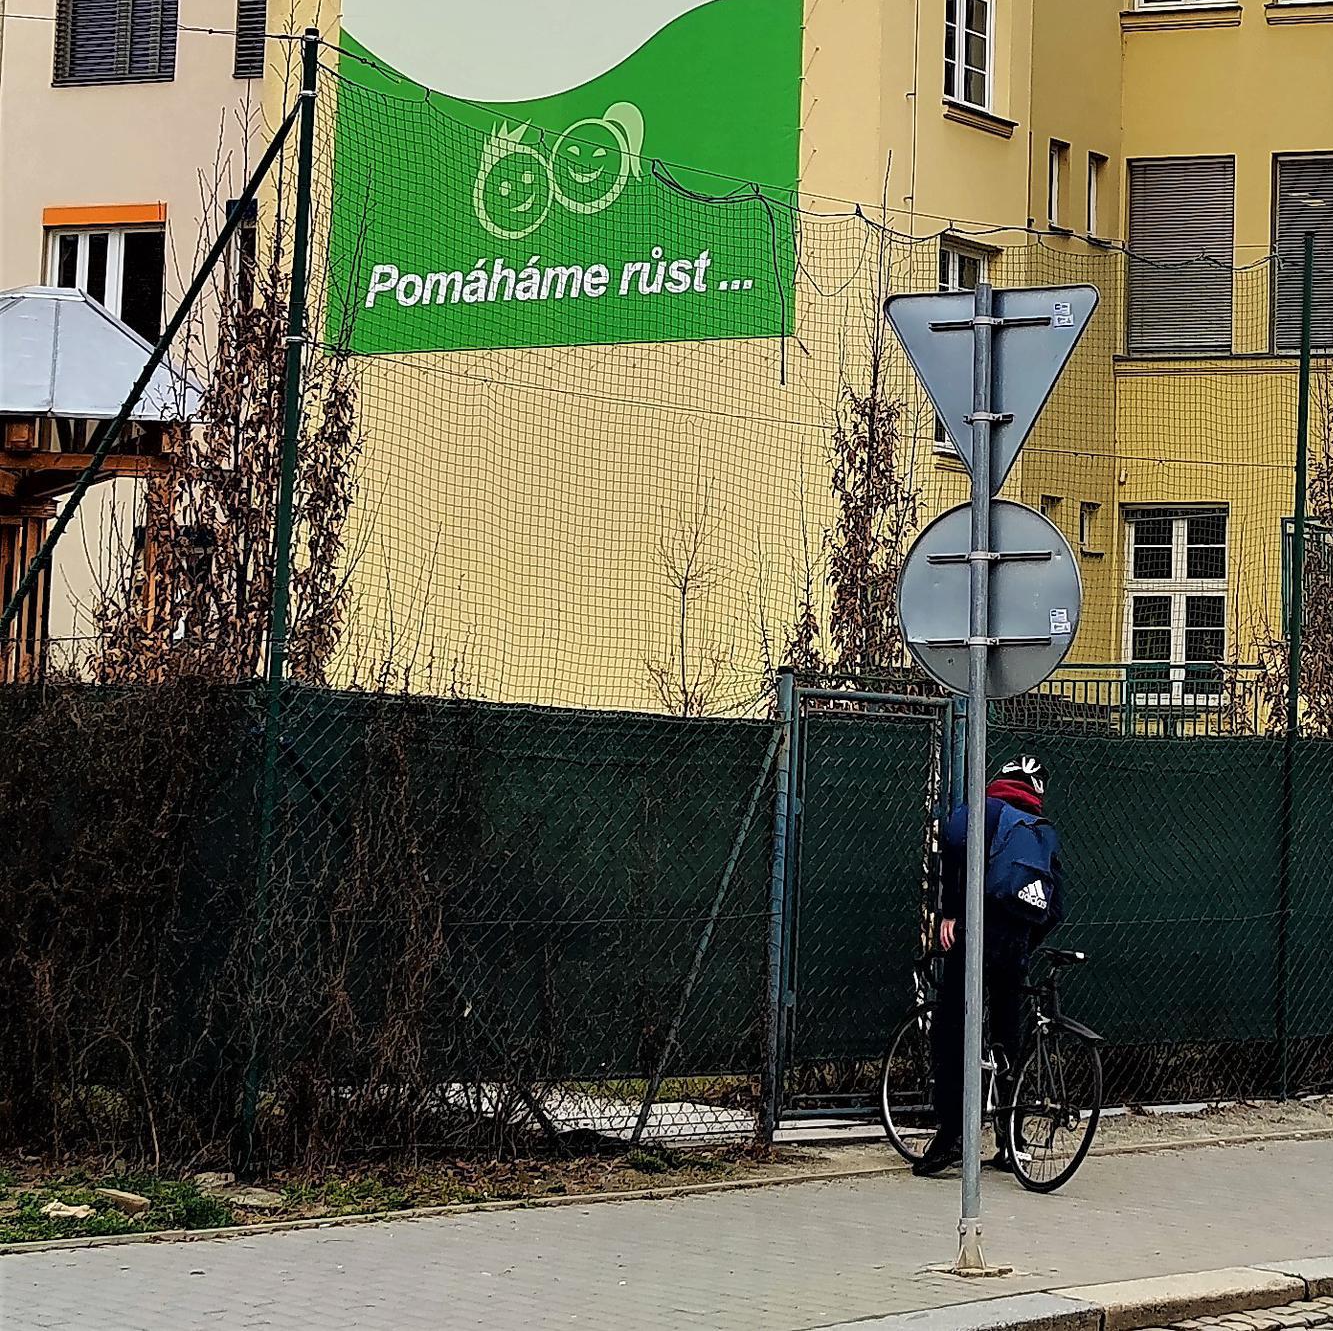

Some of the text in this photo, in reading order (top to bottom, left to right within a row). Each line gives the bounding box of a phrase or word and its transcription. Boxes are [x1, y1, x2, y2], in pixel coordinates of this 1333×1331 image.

[364, 254, 610, 309] Pomáháme
[619, 246, 713, 296] růst
[1018, 889, 1048, 910] adidas
